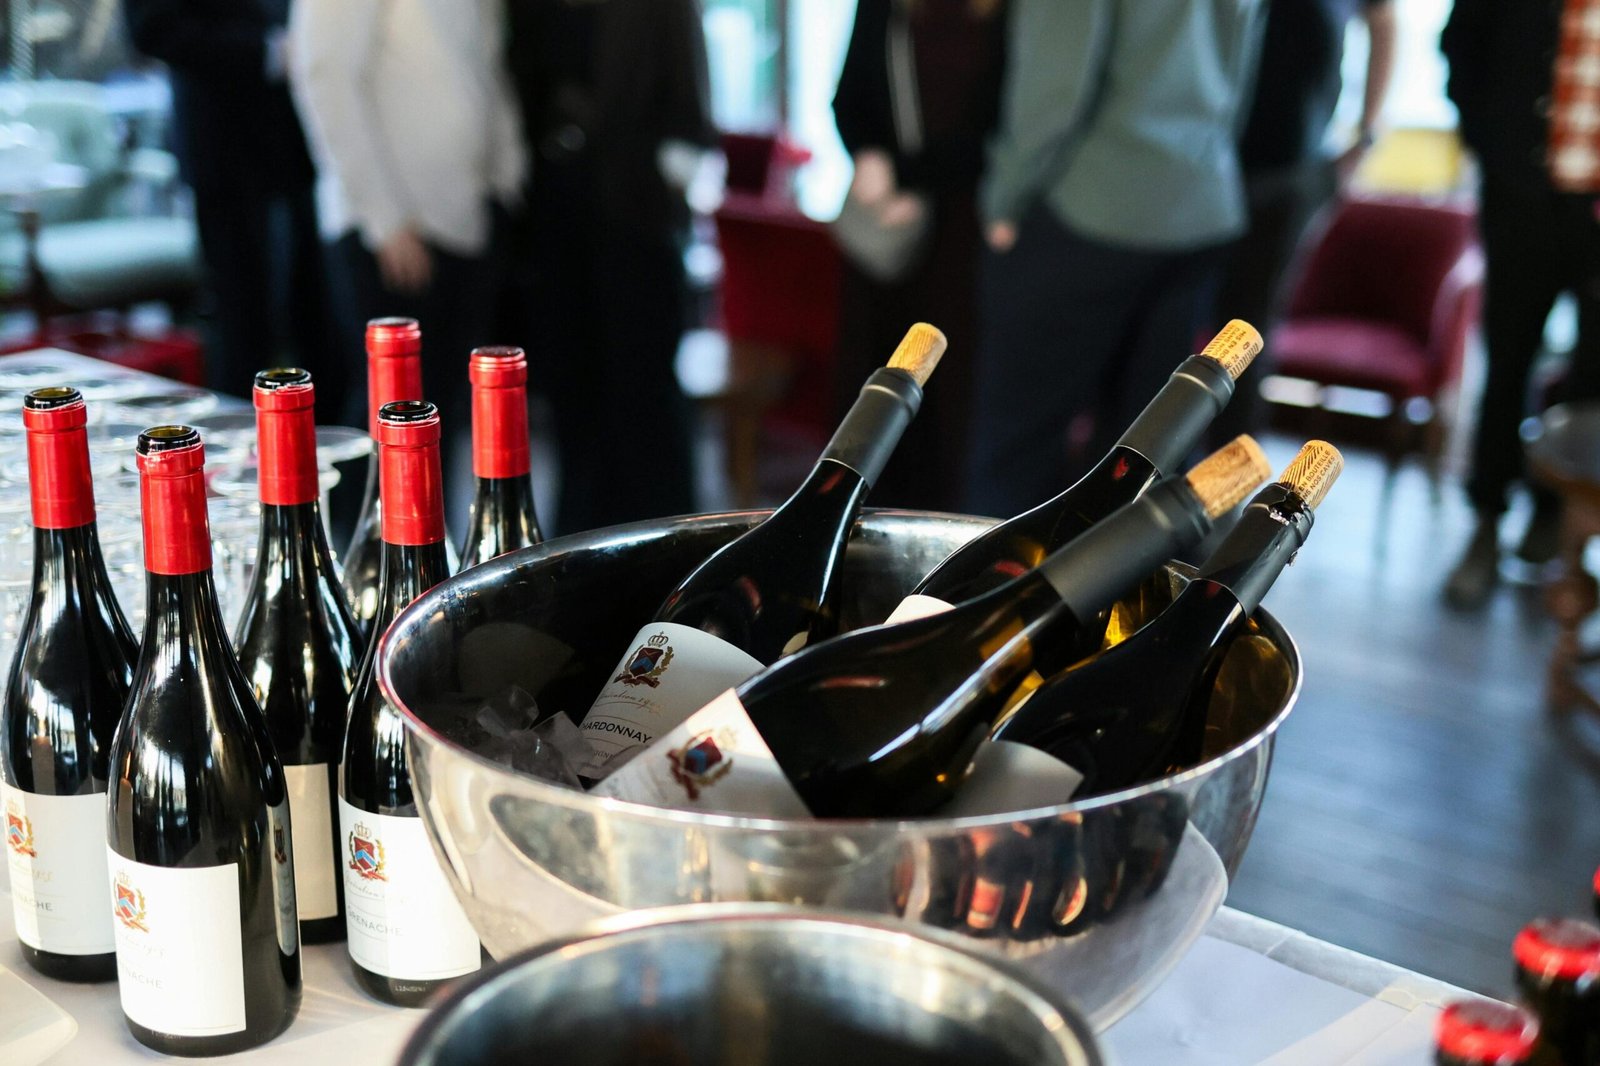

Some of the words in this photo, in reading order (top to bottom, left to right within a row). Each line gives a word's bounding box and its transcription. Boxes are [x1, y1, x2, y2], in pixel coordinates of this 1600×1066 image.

[1298, 481, 1308, 492] EN
[1305, 449, 1331, 482] BOUTEILLE
[1302, 488, 1312, 499] NS
[1310, 474, 1323, 490] NOS
[1320, 456, 1336, 477] CAVES
[583, 721, 652, 744] HARDONNAY
